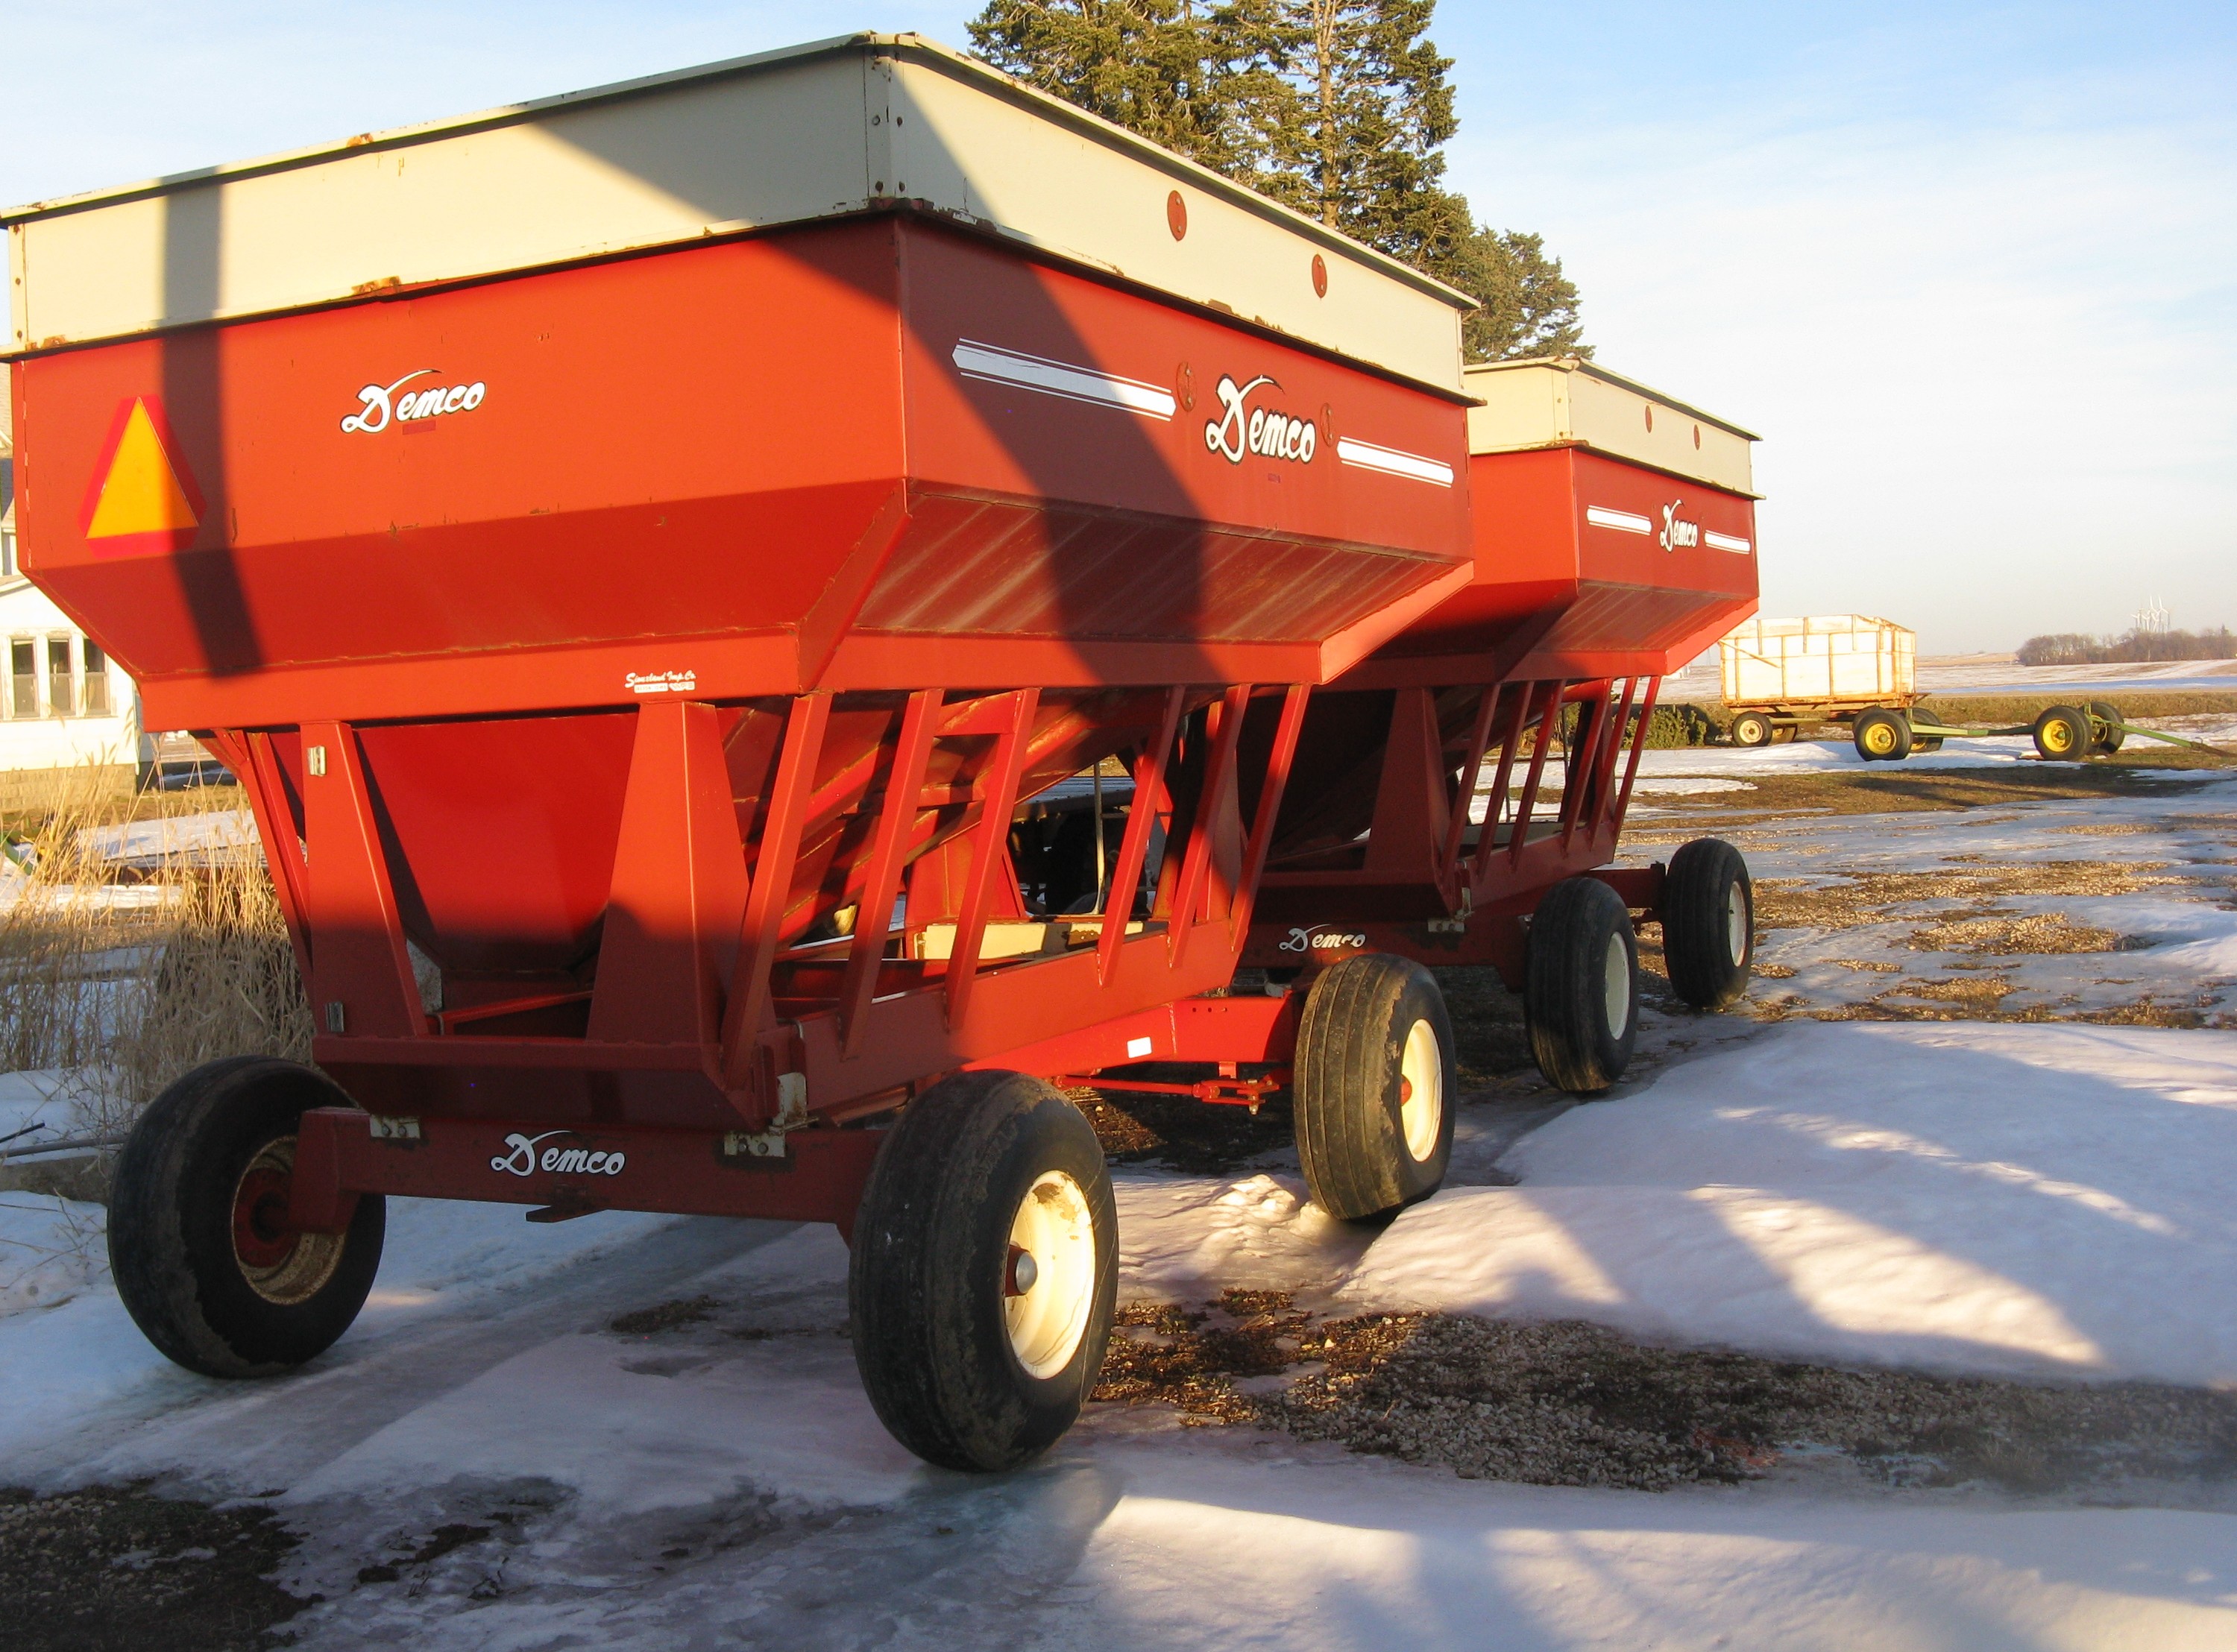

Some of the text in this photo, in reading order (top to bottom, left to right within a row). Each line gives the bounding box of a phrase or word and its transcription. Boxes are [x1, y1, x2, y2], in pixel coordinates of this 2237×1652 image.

[340, 369, 486, 433] Demco
[1204, 373, 1315, 464] Demco
[1659, 499, 1697, 552] Demco
[1278, 924, 1366, 952] Demco
[491, 1129, 626, 1177] Demco
